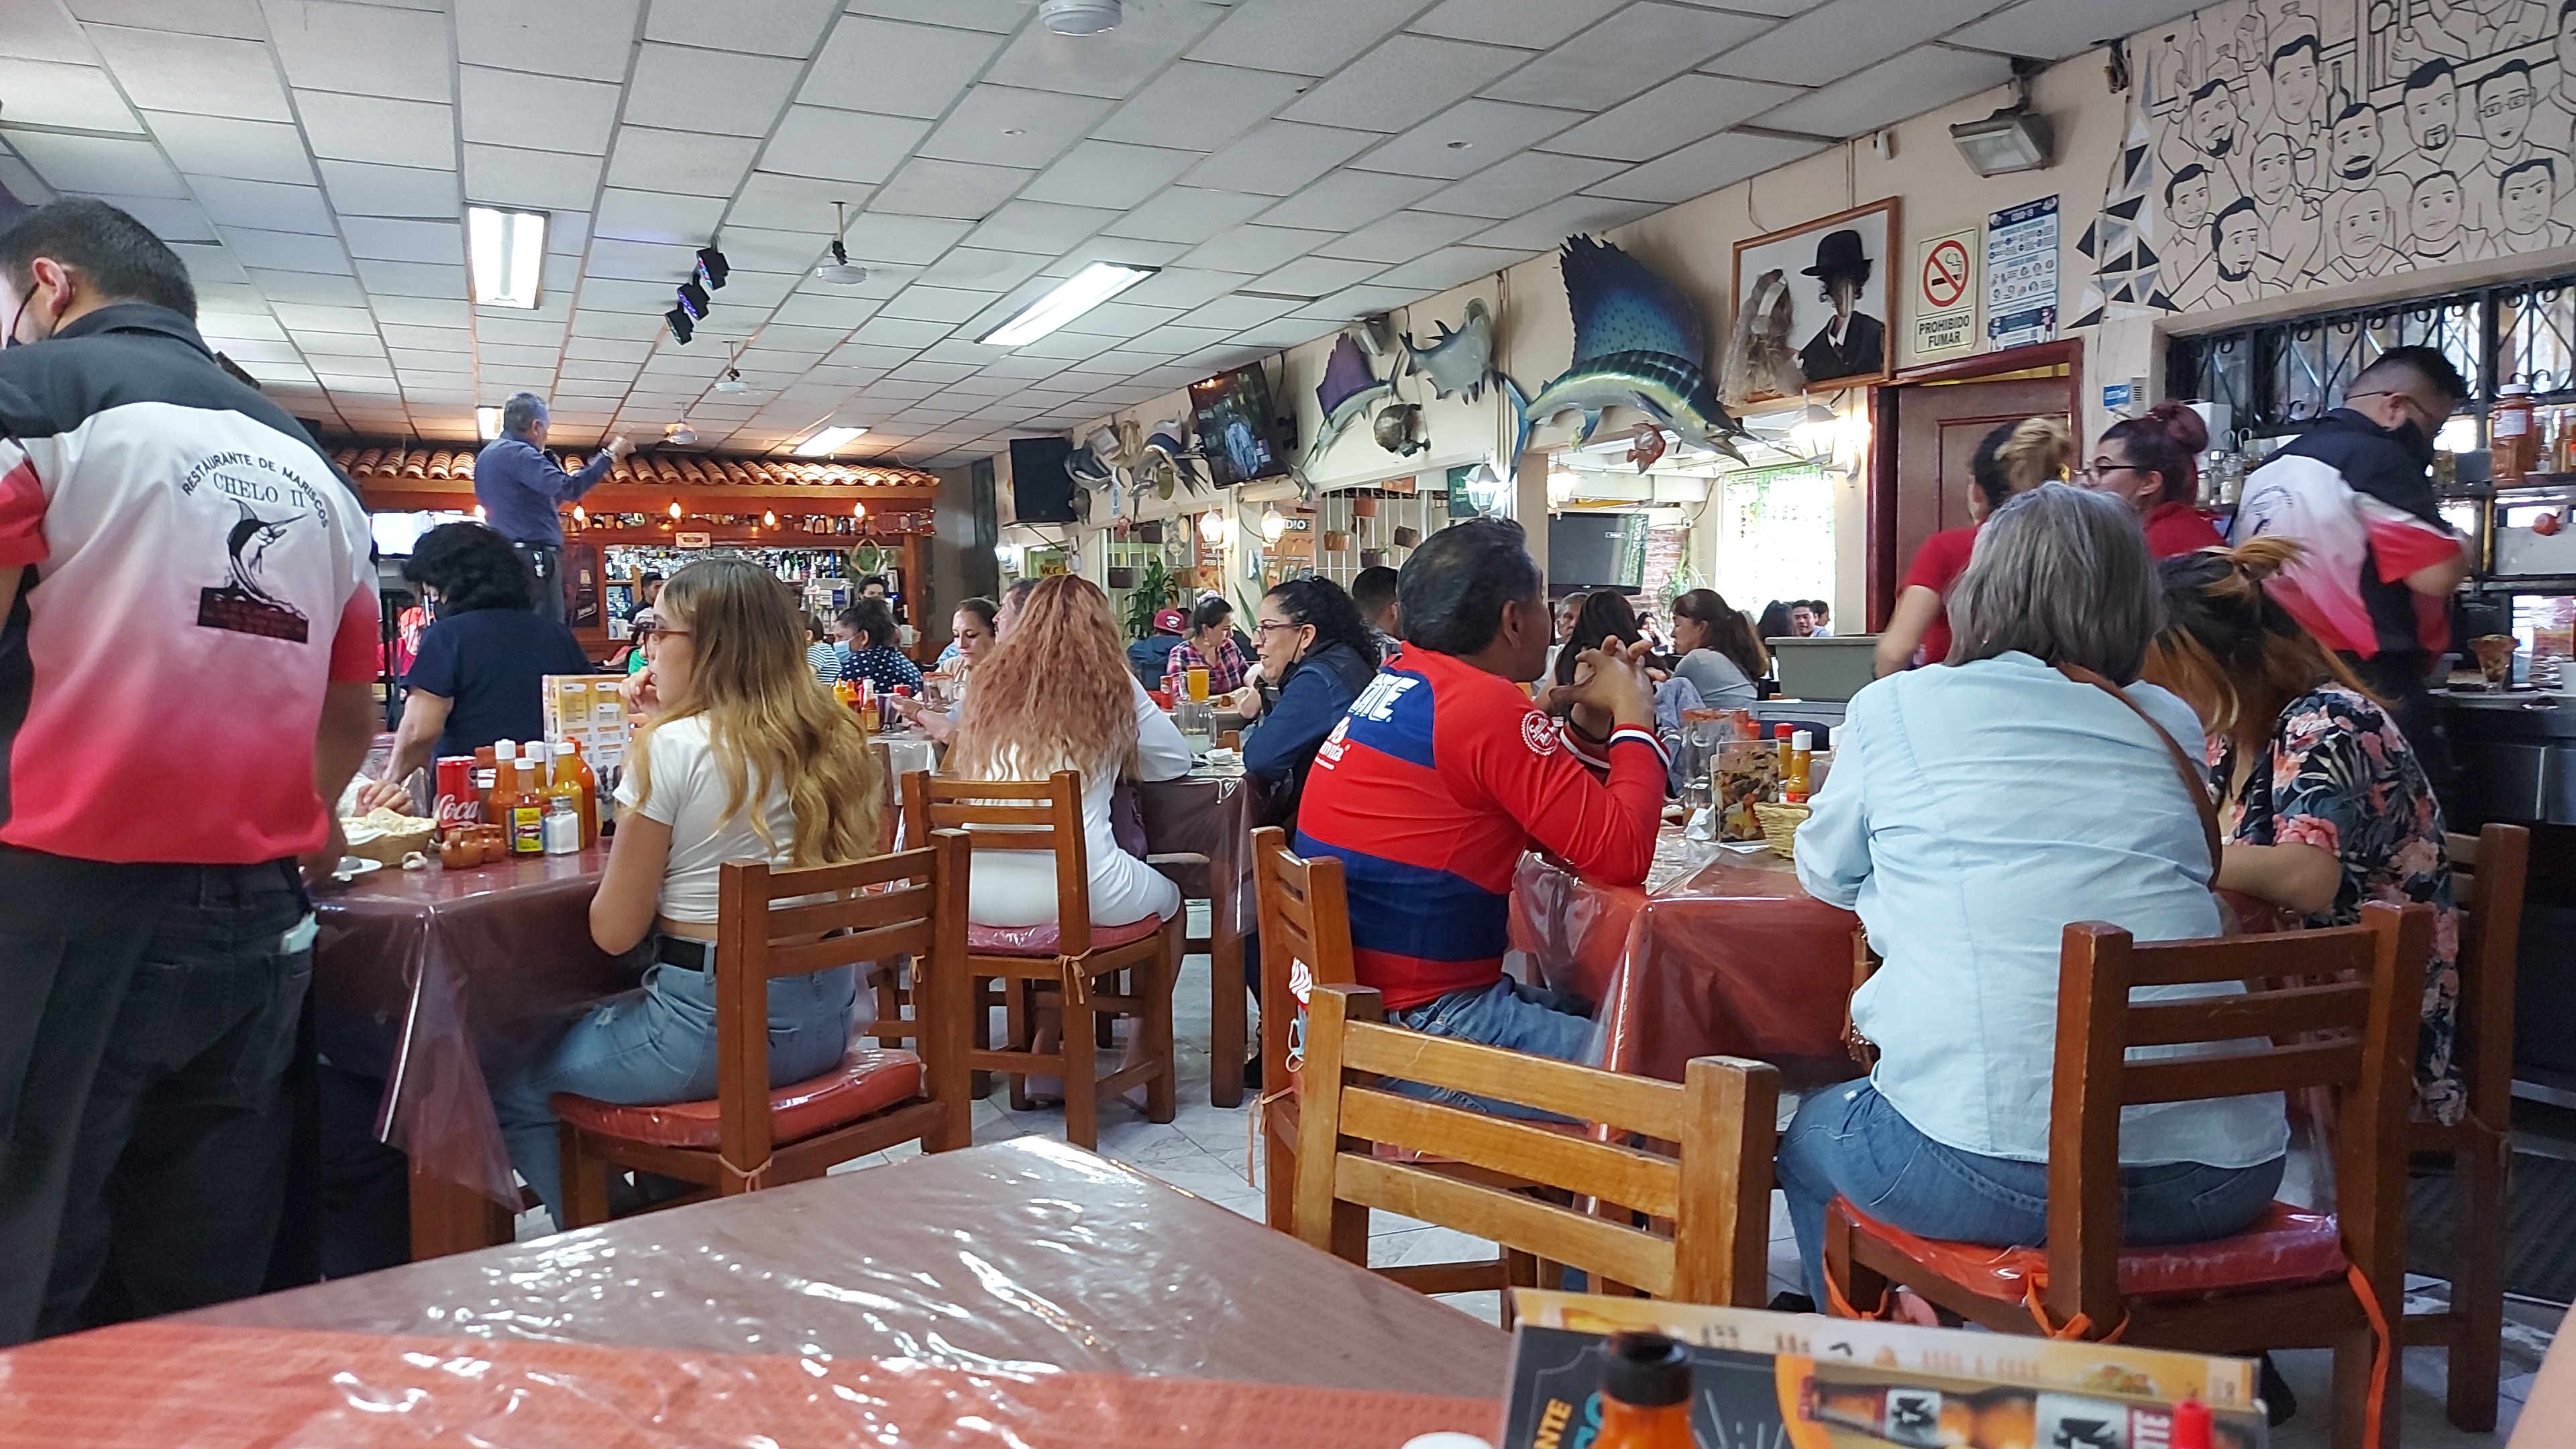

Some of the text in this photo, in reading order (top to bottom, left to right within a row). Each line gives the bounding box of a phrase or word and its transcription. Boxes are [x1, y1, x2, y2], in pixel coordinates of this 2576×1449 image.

[1919, 315, 1969, 335] PROHIBIDO
[1928, 331, 1960, 348] FUMAR
[181, 451, 329, 529] RESTAURANTE DE MARISCOS
[213, 472, 279, 503] CHELO
[439, 794, 481, 820] Coca
